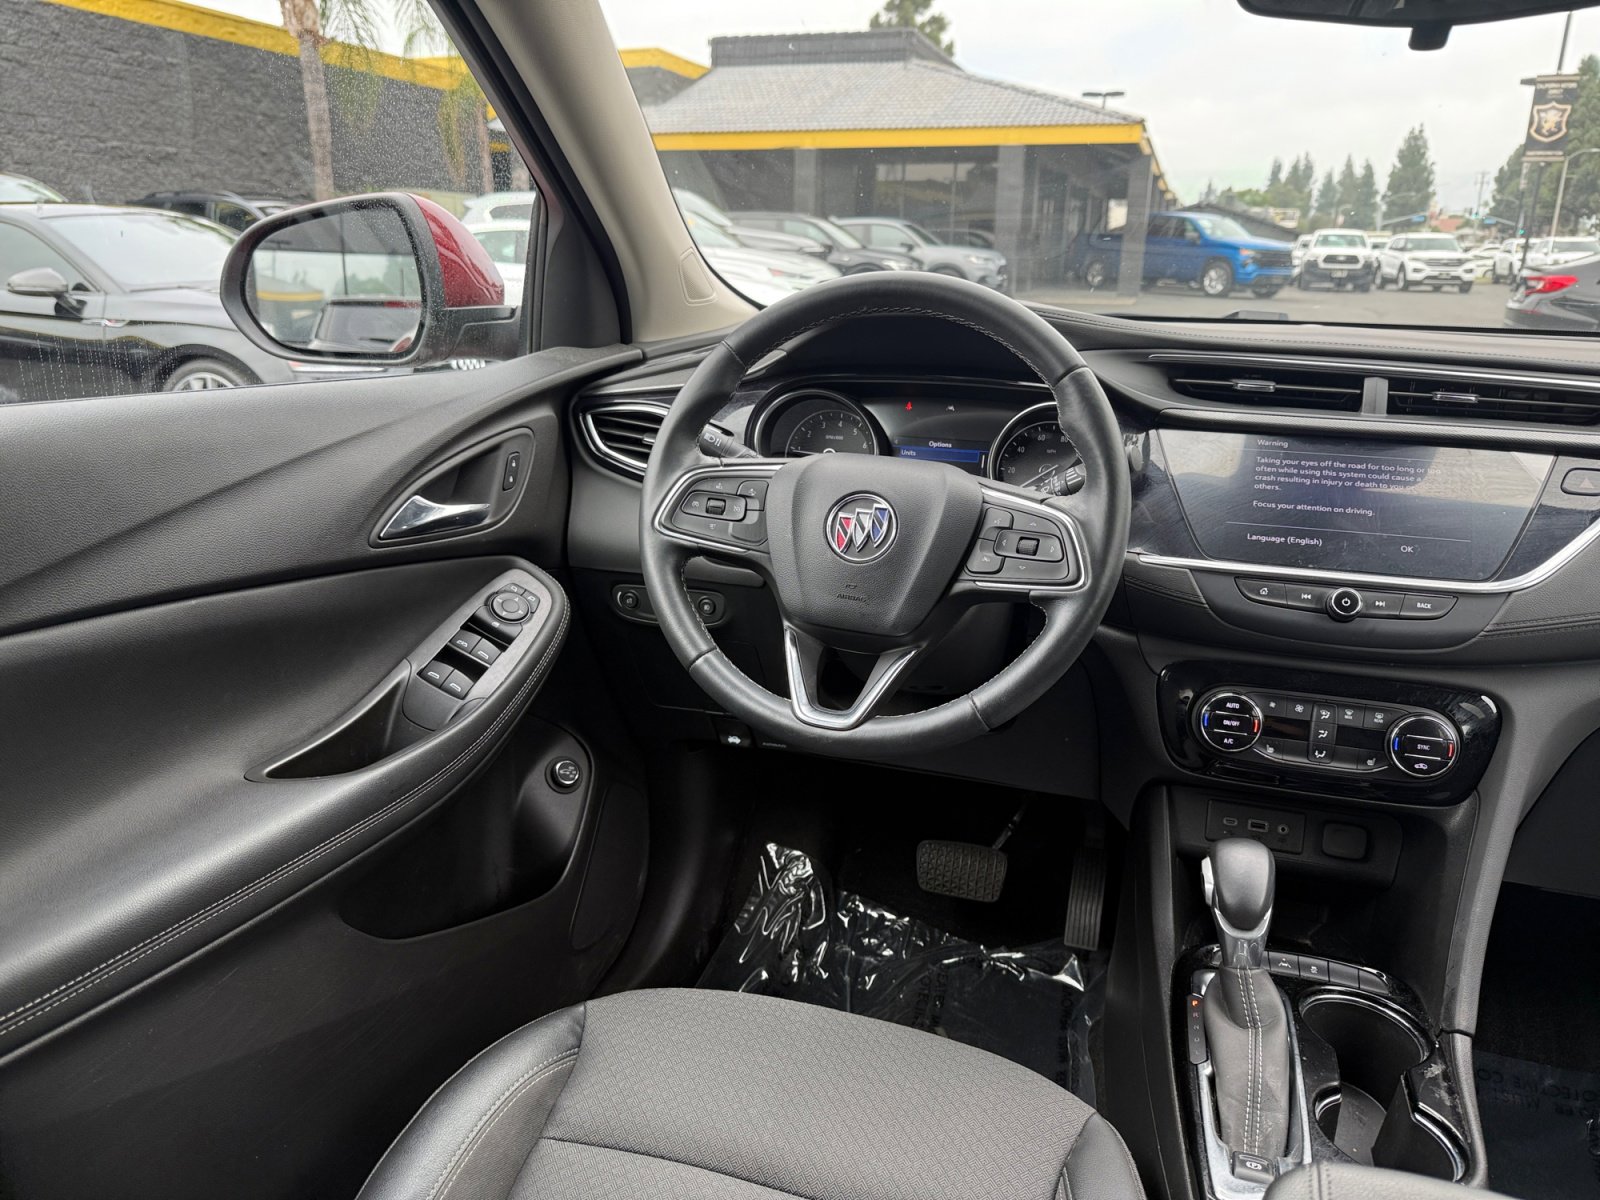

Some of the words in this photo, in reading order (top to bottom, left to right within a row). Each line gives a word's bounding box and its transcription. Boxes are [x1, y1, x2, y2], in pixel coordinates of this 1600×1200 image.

[820, 421, 827, 429] 3
[837, 420, 843, 428] 4
[807, 430, 812, 438] 2
[852, 428, 858, 436] 5
[862, 441, 867, 449] 6
[928, 440, 952, 448] Options
[1257, 439, 1288, 449] Warning
[1256, 456, 1280, 466] Taking
[1348, 462, 1366, 470] road
[1397, 465, 1415, 474] long
[1007, 466, 1016, 474] 20
[1255, 465, 1277, 473] often
[1300, 468, 1321, 477] using
[1338, 470, 1366, 479] system
[1367, 472, 1390, 480] could
[1254, 474, 1276, 482] crash
[1277, 476, 1311, 485] resulting
[1321, 478, 1343, 487] injury
[1354, 480, 1378, 488] death
[1253, 482, 1282, 491] others.
[1252, 500, 1276, 509] Focus
[1277, 503, 1295, 511] your
[1296, 504, 1332, 513] attention
[1345, 507, 1376, 517] driving.
[1246, 533, 1285, 544] Language
[1287, 535, 1323, 547] (English)
[1400, 545, 1414, 553] OK
[1222, 719, 1240, 727] ON/OFF
